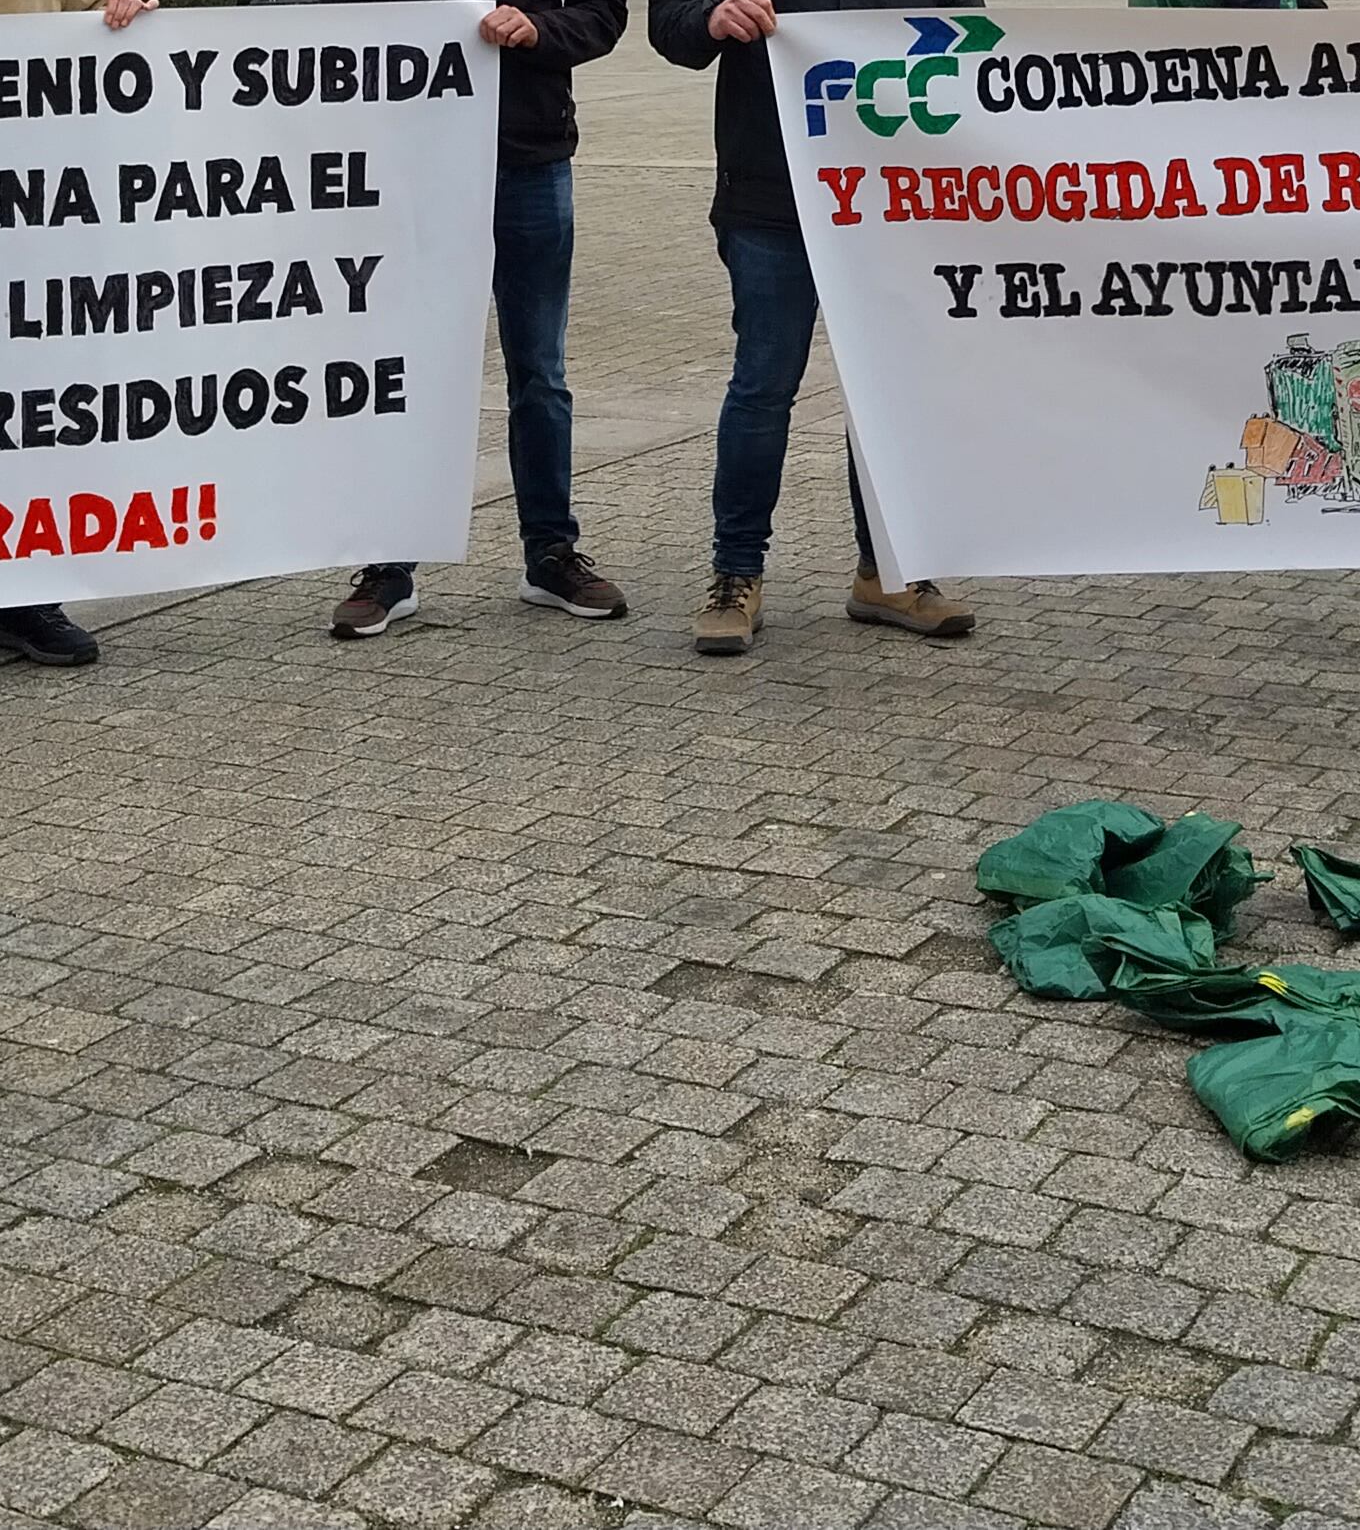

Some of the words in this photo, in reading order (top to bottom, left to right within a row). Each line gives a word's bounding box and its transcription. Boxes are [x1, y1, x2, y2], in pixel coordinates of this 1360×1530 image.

[169, 50, 219, 111] Y
[233, 41, 474, 107] SUBIDA
[804, 55, 961, 137] FCC
[976, 45, 1290, 113] CONDENA
[119, 155, 296, 224] PARA
[310, 151, 380, 210] EL
[817, 166, 864, 225] Y
[883, 158, 1207, 222] RECOGIDA
[1216, 154, 1308, 215] DE
[8, 260, 324, 340] LIMPIEZA
[334, 255, 384, 313] Y
[934, 264, 983, 319] Y
[1000, 263, 1082, 318] EL
[324, 356, 407, 418] DE
